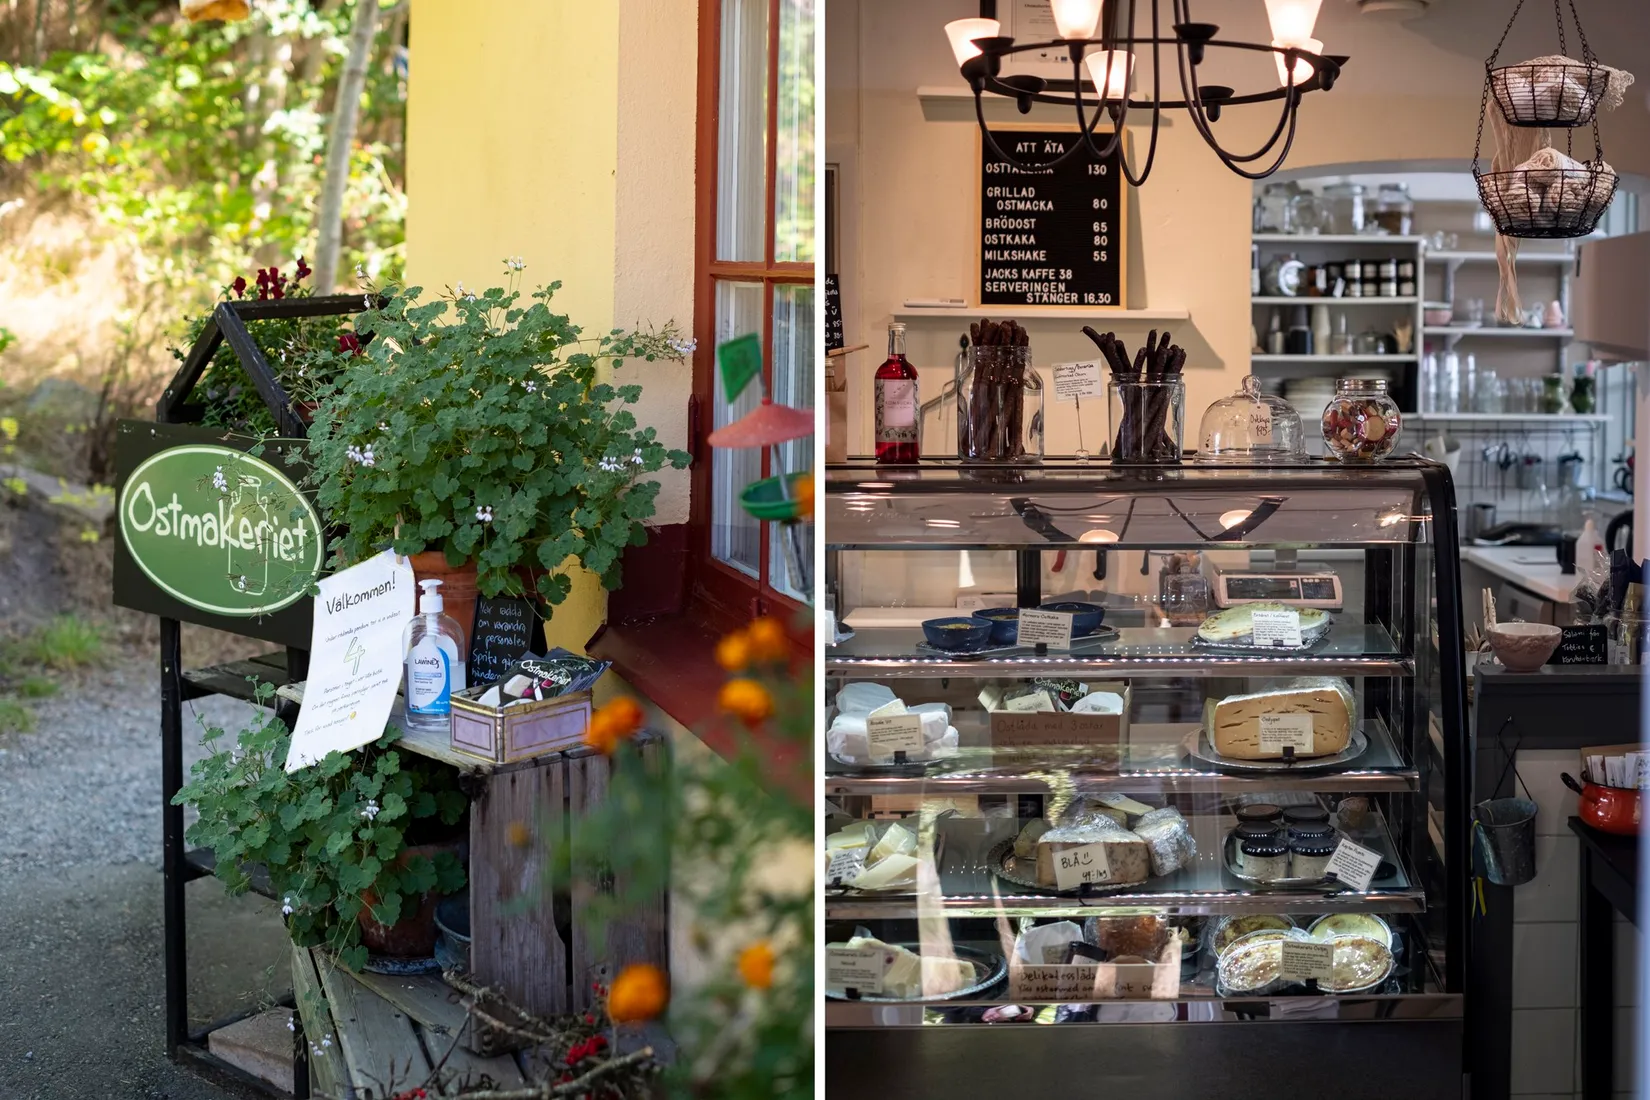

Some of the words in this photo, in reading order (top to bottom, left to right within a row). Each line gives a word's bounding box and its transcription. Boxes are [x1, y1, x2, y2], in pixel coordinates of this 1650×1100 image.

[1016, 142, 1037, 154] ATT
[1044, 140, 1064, 154] ÄTA
[1088, 164, 1107, 176] 130
[986, 187, 1036, 198] GRILLAD
[996, 200, 1054, 211] OSTMACKA
[1092, 199, 1108, 210] 80
[986, 215, 1036, 229] BRÖDOST
[1092, 222, 1108, 232] 65
[984, 234, 1036, 244] OSTKAKA
[1093, 236, 1108, 246] 80
[984, 250, 1047, 261] MILKSHAKE
[1092, 251, 1107, 262] 55
[985, 269, 1018, 280] JACKS
[1022, 269, 1056, 280] KAFFE
[1059, 269, 1072, 280] 38
[985, 282, 1066, 292] SERVERINGEN
[1026, 291, 1078, 303] STÄNGER
[1084, 292, 1111, 304] 16.30
[128, 480, 309, 563] Ostmakeriet
[326, 571, 396, 615] Välkommen!
[478, 620, 490, 628] om
[344, 636, 366, 676] 4
[472, 648, 498, 665] Sprita
[521, 660, 572, 685] Ostmakeriet
[1044, 720, 1063, 730] med
[1061, 852, 1080, 869] BLÅ
